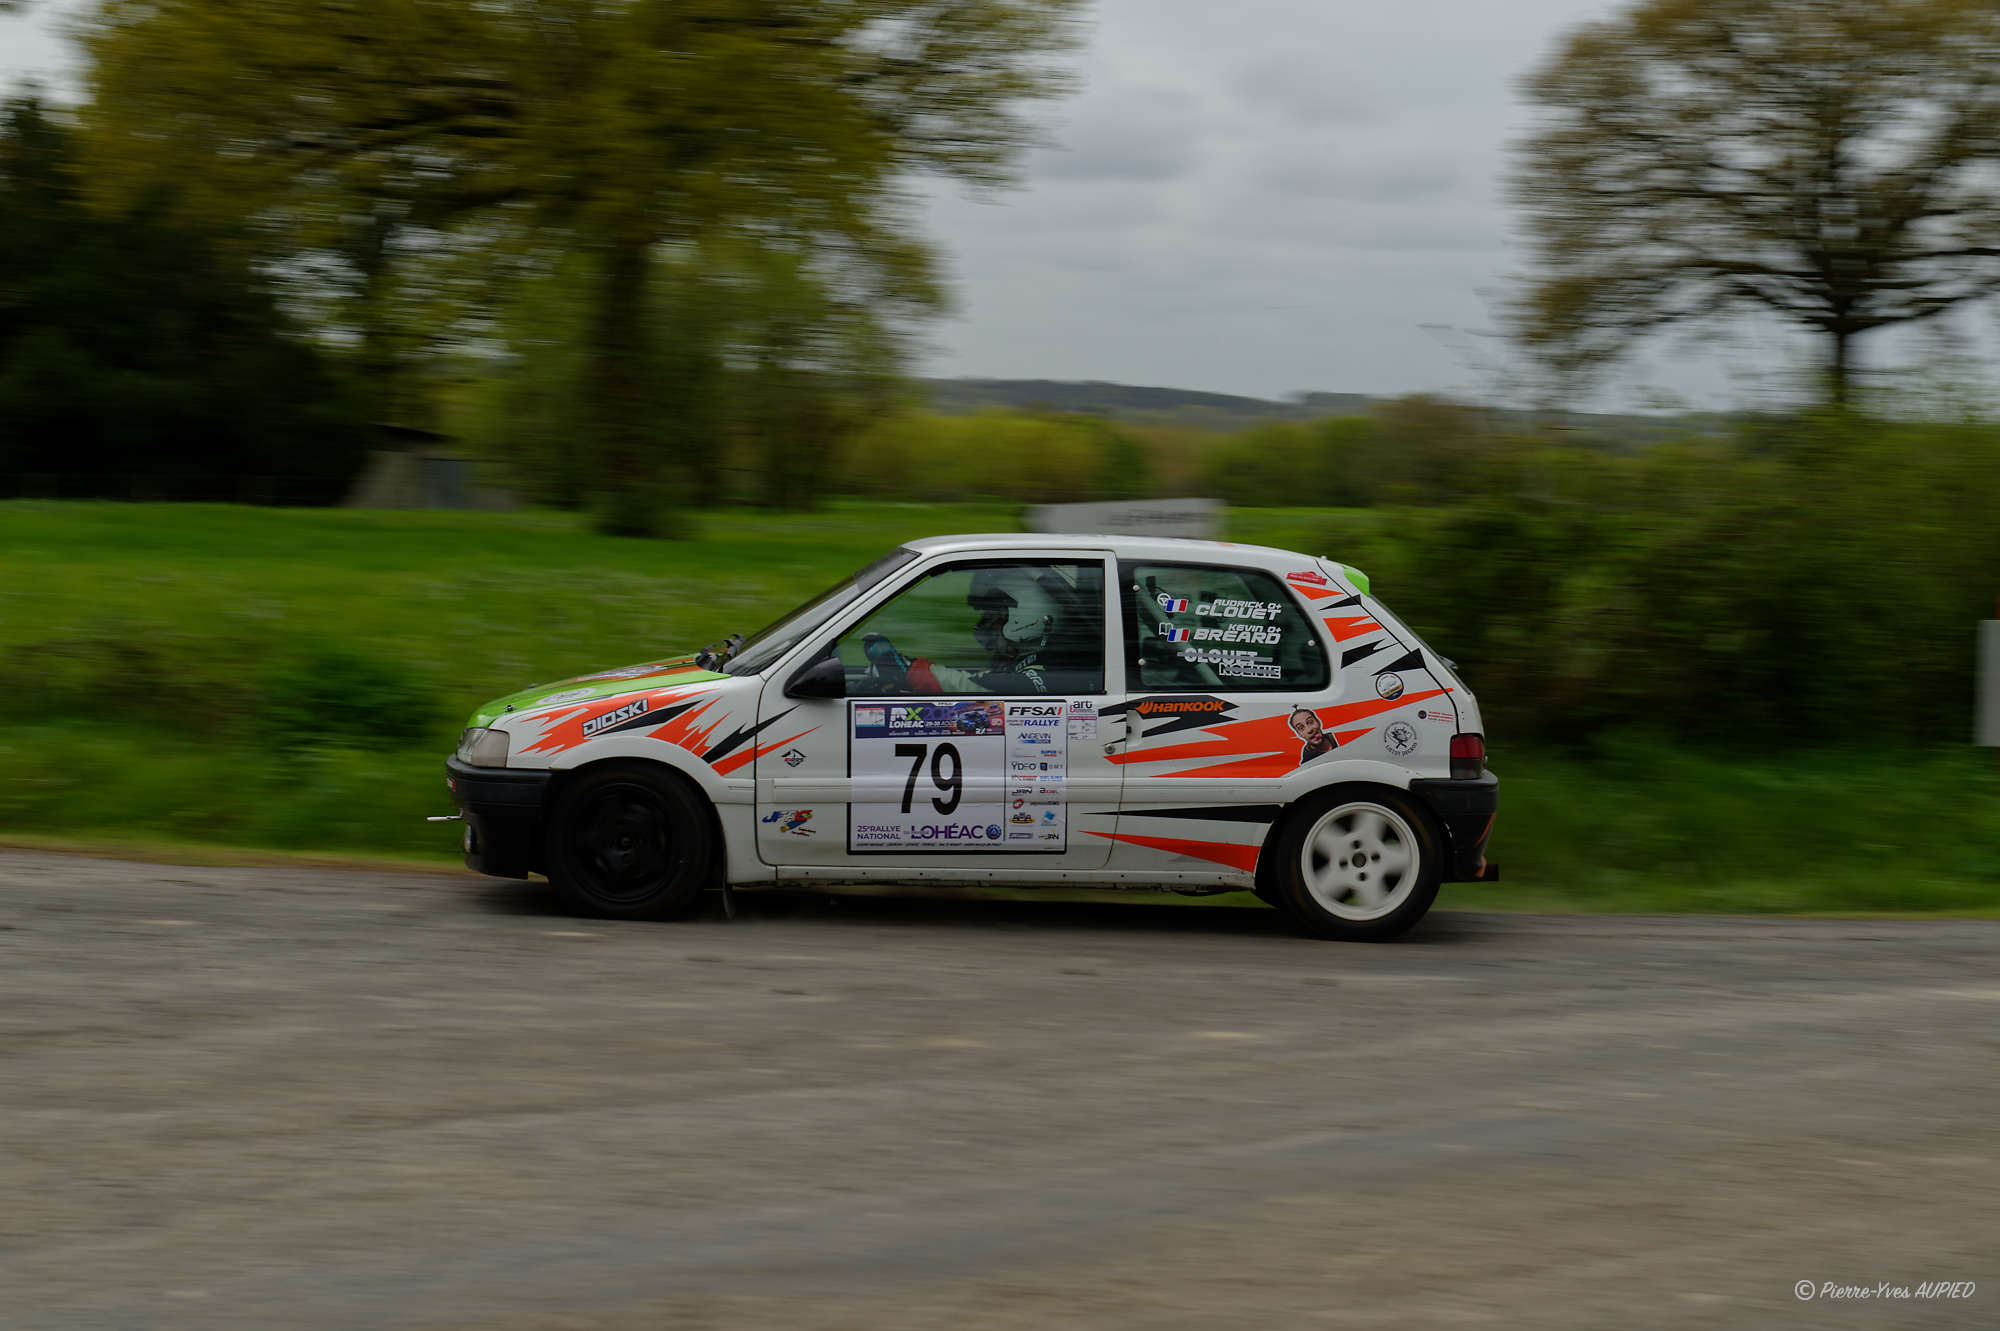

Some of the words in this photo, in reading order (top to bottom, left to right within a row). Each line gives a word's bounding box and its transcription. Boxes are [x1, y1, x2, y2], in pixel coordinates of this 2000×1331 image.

[1213, 599, 1264, 608] AUDRICK
[1195, 604, 1281, 620] CLOUET
[1228, 623, 1264, 632] KEVIN
[1194, 628, 1281, 644] BREARD
[1009, 706, 1056, 715] FFSA
[895, 742, 963, 815] 79
[911, 823, 983, 839] LOHÉAC
